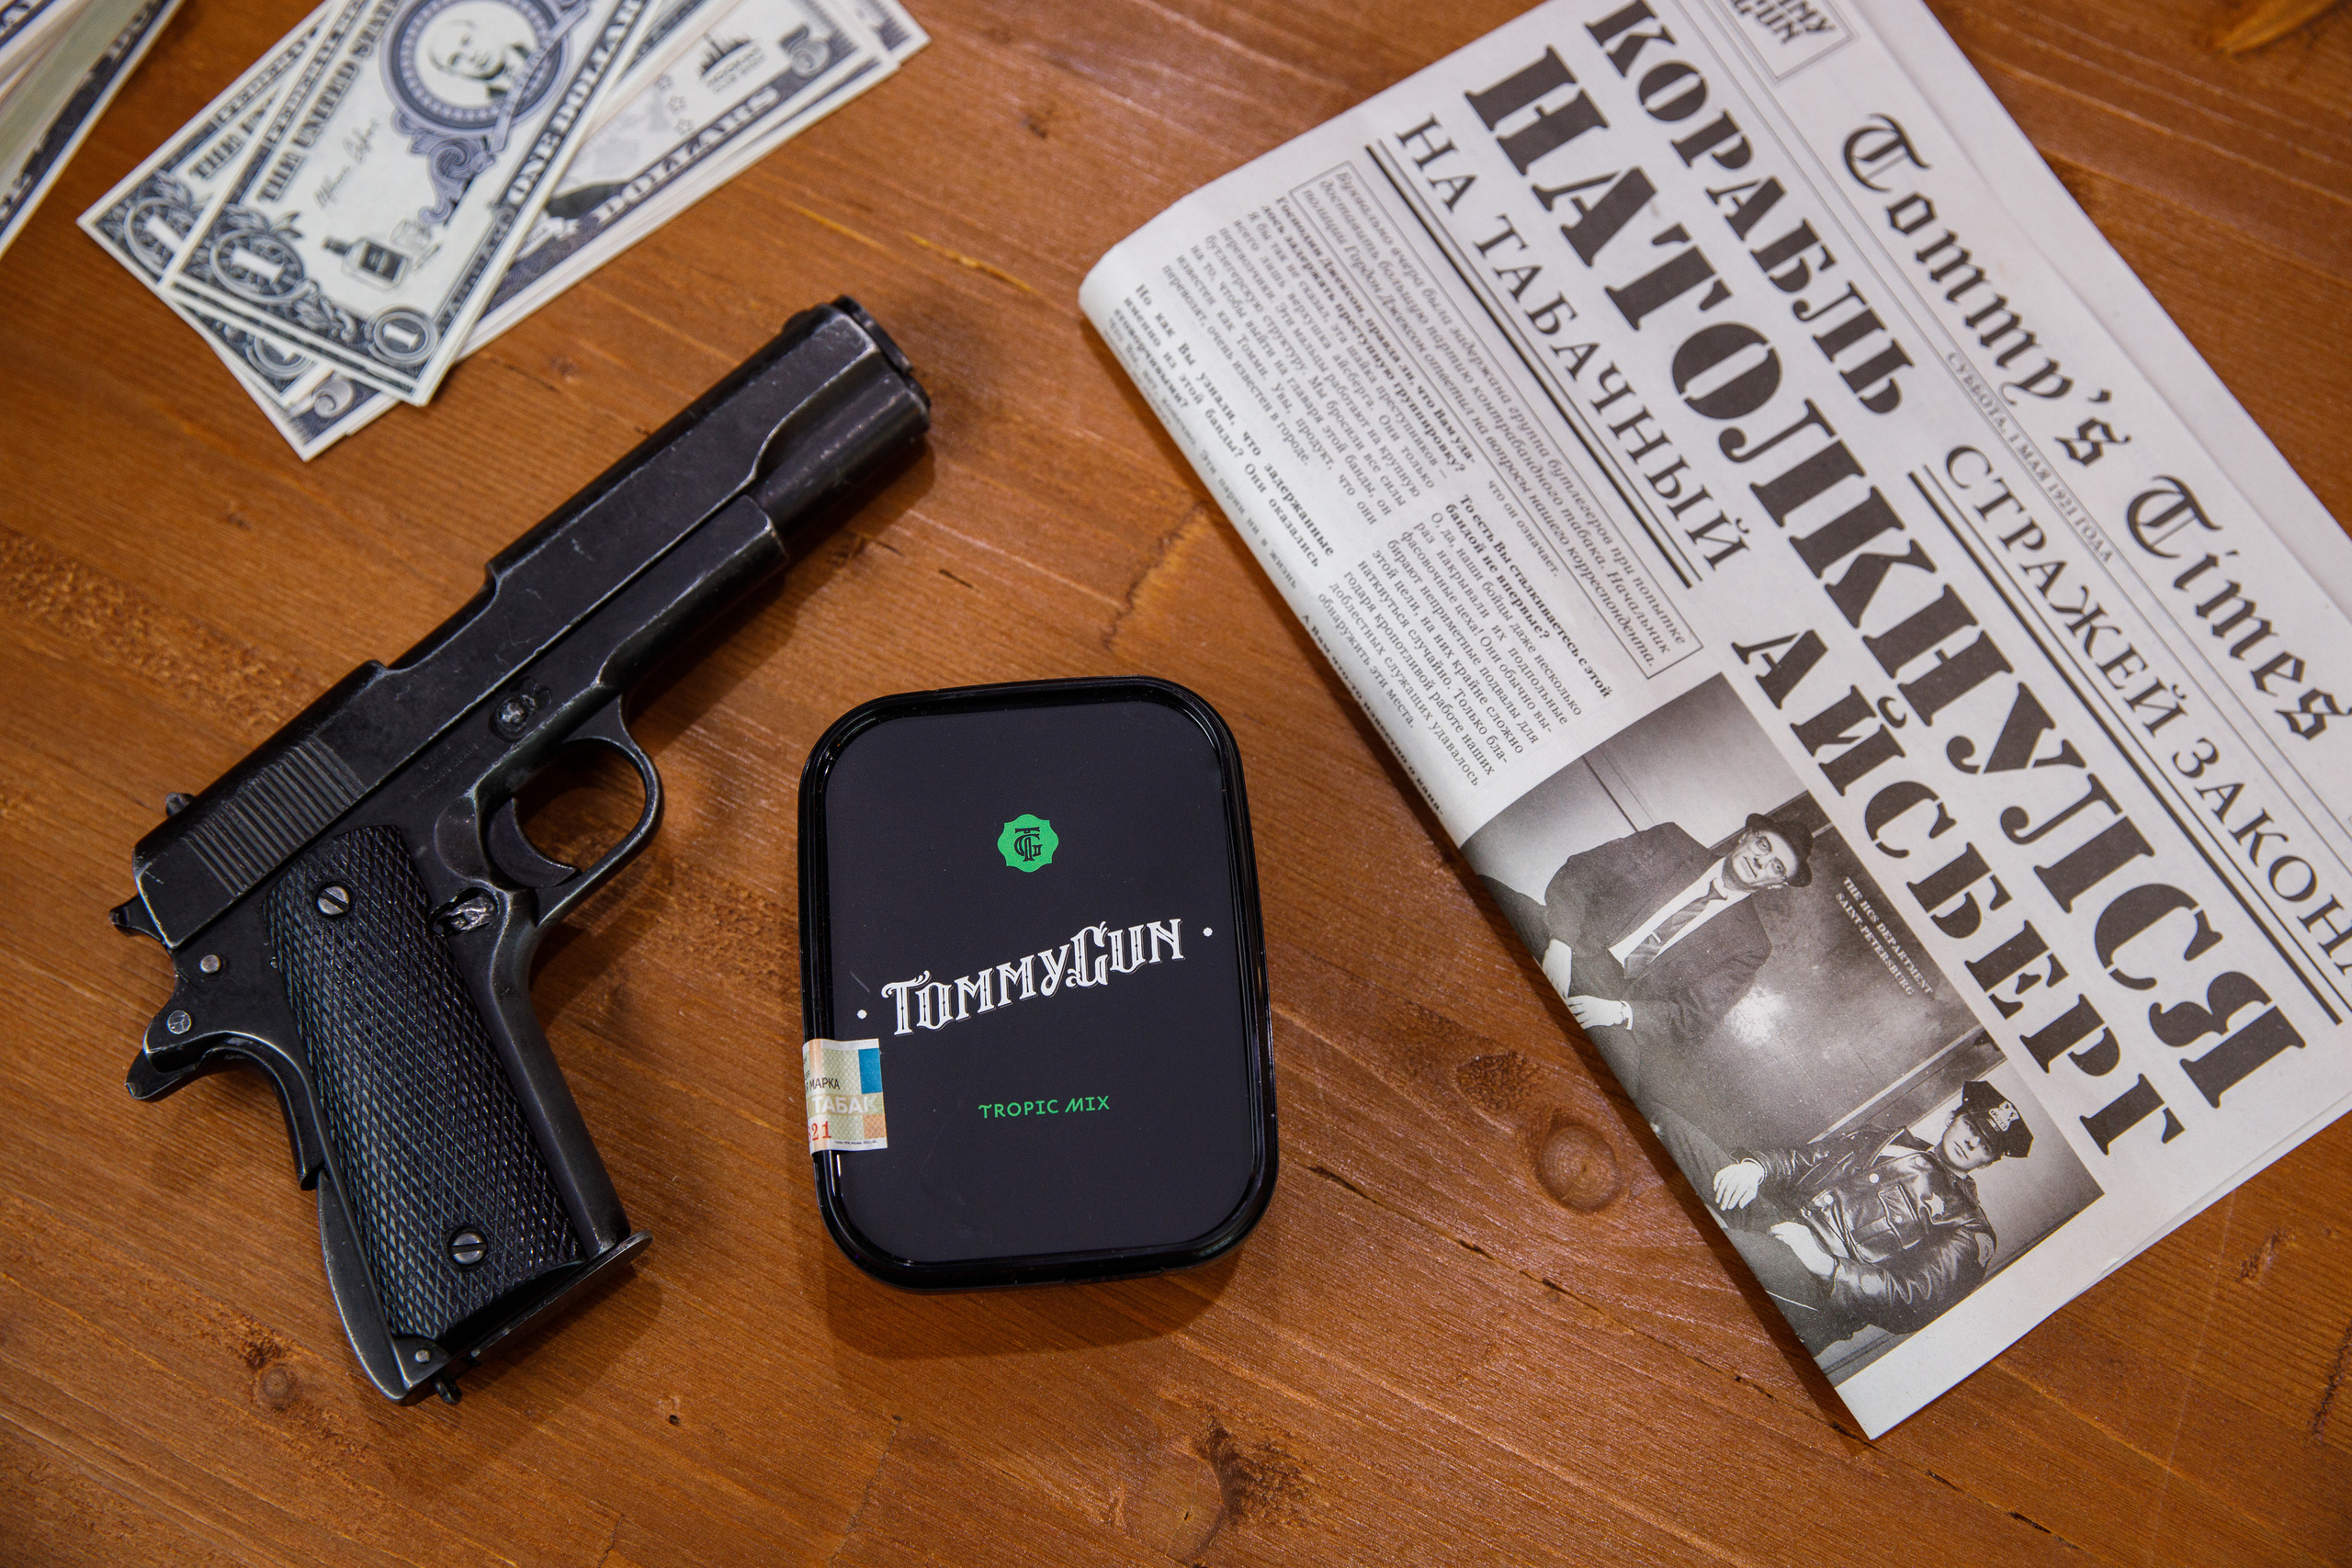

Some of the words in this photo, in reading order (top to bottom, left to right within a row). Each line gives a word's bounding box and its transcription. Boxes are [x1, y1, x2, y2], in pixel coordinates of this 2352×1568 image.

[1585, 0, 1913, 413] КОРАБЛЬ
[1374, 384, 1439, 467] преступников
[1392, 381, 1466, 471] группировку?
[1397, 117, 1476, 211] НА
[1476, 215, 1748, 570] ТАБАЧНЫЙ
[1432, 407, 1456, 436] Вам
[1843, 115, 2130, 466] Tommy's
[2126, 476, 2351, 739] Times
[1263, 464, 1334, 556] задержанные
[1267, 497, 1318, 568] оказались
[1338, 472, 1356, 496] что
[1355, 500, 1377, 525] они
[1362, 451, 1382, 472] все
[1379, 474, 1407, 507] силы
[1375, 498, 1392, 516] он
[1378, 444, 1420, 498] крупную
[1400, 444, 1435, 489] только
[1422, 353, 1476, 416] ответил
[1470, 415, 1489, 435] на
[1485, 434, 1532, 493] вопросы
[1527, 493, 1570, 546] нашего
[1425, 324, 1475, 384] партию
[1470, 384, 1564, 506] контрабандного
[1605, 570, 1670, 654] Начальник
[1449, 327, 1512, 404] задержана
[1507, 406, 1551, 457] группа
[1546, 457, 1613, 546] бутлегеров
[1610, 546, 1635, 575] при
[1631, 576, 1686, 644] попытке
[1487, 479, 1506, 502] что
[1502, 502, 1519, 519] он
[1515, 519, 1559, 577] означает.
[2014, 441, 2052, 484] МАЯ
[2044, 479, 2079, 518] 1921
[2071, 513, 2116, 565] ГОДА
[1317, 592, 1371, 666] обнаружить
[1368, 665, 1388, 689] эти
[1385, 687, 1414, 728] места.
[1356, 559, 1410, 628] наткнуться
[1407, 627, 1452, 690] случайно.
[1452, 686, 1488, 736] Только
[1485, 734, 1508, 763] бла-
[1371, 548, 1399, 580] этой
[1393, 579, 1420, 616] цели,
[1419, 615, 1436, 634] на
[1432, 632, 1454, 659] них
[1451, 658, 1488, 705] крайне
[1485, 705, 1524, 754] сложно
[1386, 538, 1423, 584] бирают
[1419, 584, 1482, 666] неприметные
[1477, 665, 1521, 719] подвалы
[1515, 719, 1539, 744] для
[1399, 530, 1458, 604] фасовочные
[1453, 603, 1485, 637] цеха!
[1478, 635, 1502, 663] Они
[1498, 662, 1536, 710] обычно
[1532, 709, 1552, 733] вы-
[1411, 521, 1436, 545] раз
[1435, 548, 1490, 619] накрывали
[1490, 624, 1508, 642] их
[1507, 646, 1568, 725] подпольные
[1430, 511, 1444, 529] О,
[1439, 528, 1456, 548] да,
[1454, 547, 1484, 581] наши
[1480, 580, 1514, 622] бойцы
[1508, 622, 1537, 653] даже
[1532, 653, 1582, 716] несколько
[1444, 502, 1487, 554] бандой
[1481, 554, 1498, 572] не
[1495, 573, 1550, 638] впервые?
[1459, 492, 1475, 513] То
[1471, 513, 1494, 543] есть
[1492, 539, 1512, 564] Вы
[1508, 563, 1579, 658] сталкиваетесь
[1583, 665, 1612, 698] этой
[1464, 46, 2305, 1108] НАТОЛКНУЛСЯ
[1328, 581, 1386, 656] доблестных
[1383, 655, 1433, 721] служащих
[1427, 720, 1478, 786] удавалось
[1342, 570, 1377, 614] годаря
[1373, 612, 1436, 692] кропотливой
[1427, 690, 1464, 734] работе
[1460, 732, 1495, 775] наших
[1945, 446, 2186, 736] СТРАЖЕЙ
[2172, 738, 2351, 975] ЗАКОН
[1731, 629, 2184, 1155] АЙСБЕРГ
[1837, 893, 1915, 996] SAINT-PETERSBURG
[1843, 876, 1863, 901] THE
[1876, 922, 1933, 995] DEPARTMENT
[978, 1099, 1059, 1119] TROPIC
[1065, 1095, 1110, 1112] MIX
